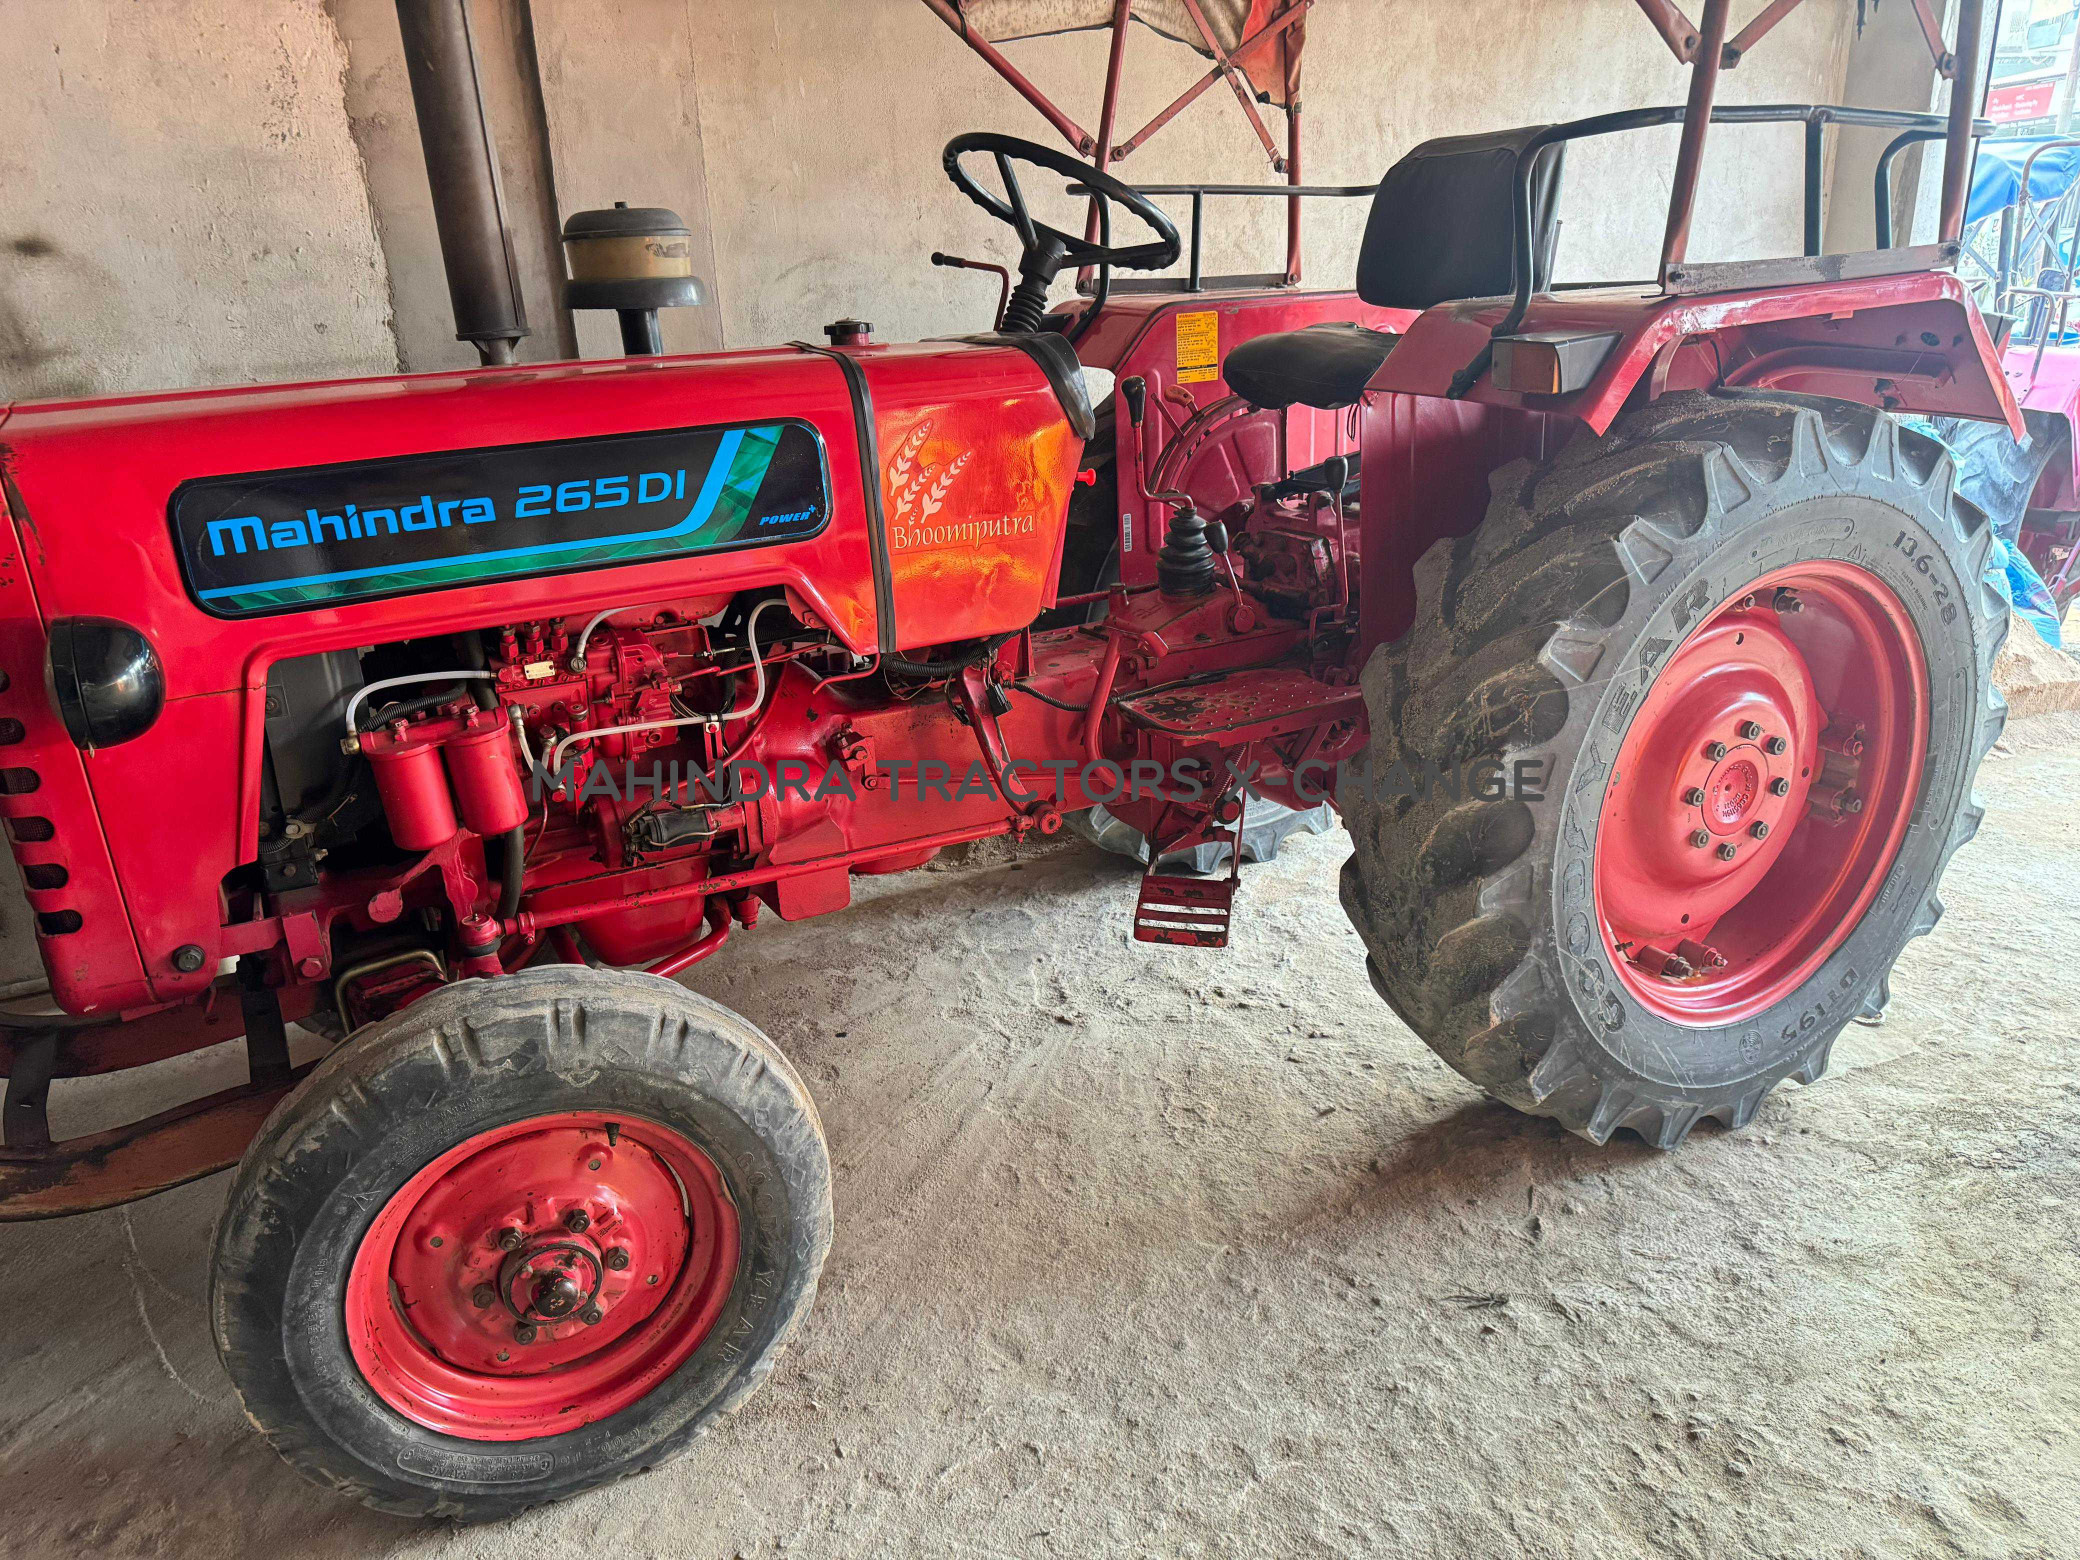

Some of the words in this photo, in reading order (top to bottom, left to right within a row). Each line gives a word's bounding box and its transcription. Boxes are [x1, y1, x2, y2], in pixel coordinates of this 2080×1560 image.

[206, 492, 497, 557] Mahindra
[515, 475, 630, 519] 265
[637, 469, 685, 505] DI
[892, 514, 1034, 549] Bhoomiputra
[1892, 529, 1958, 626] 13.6-28
